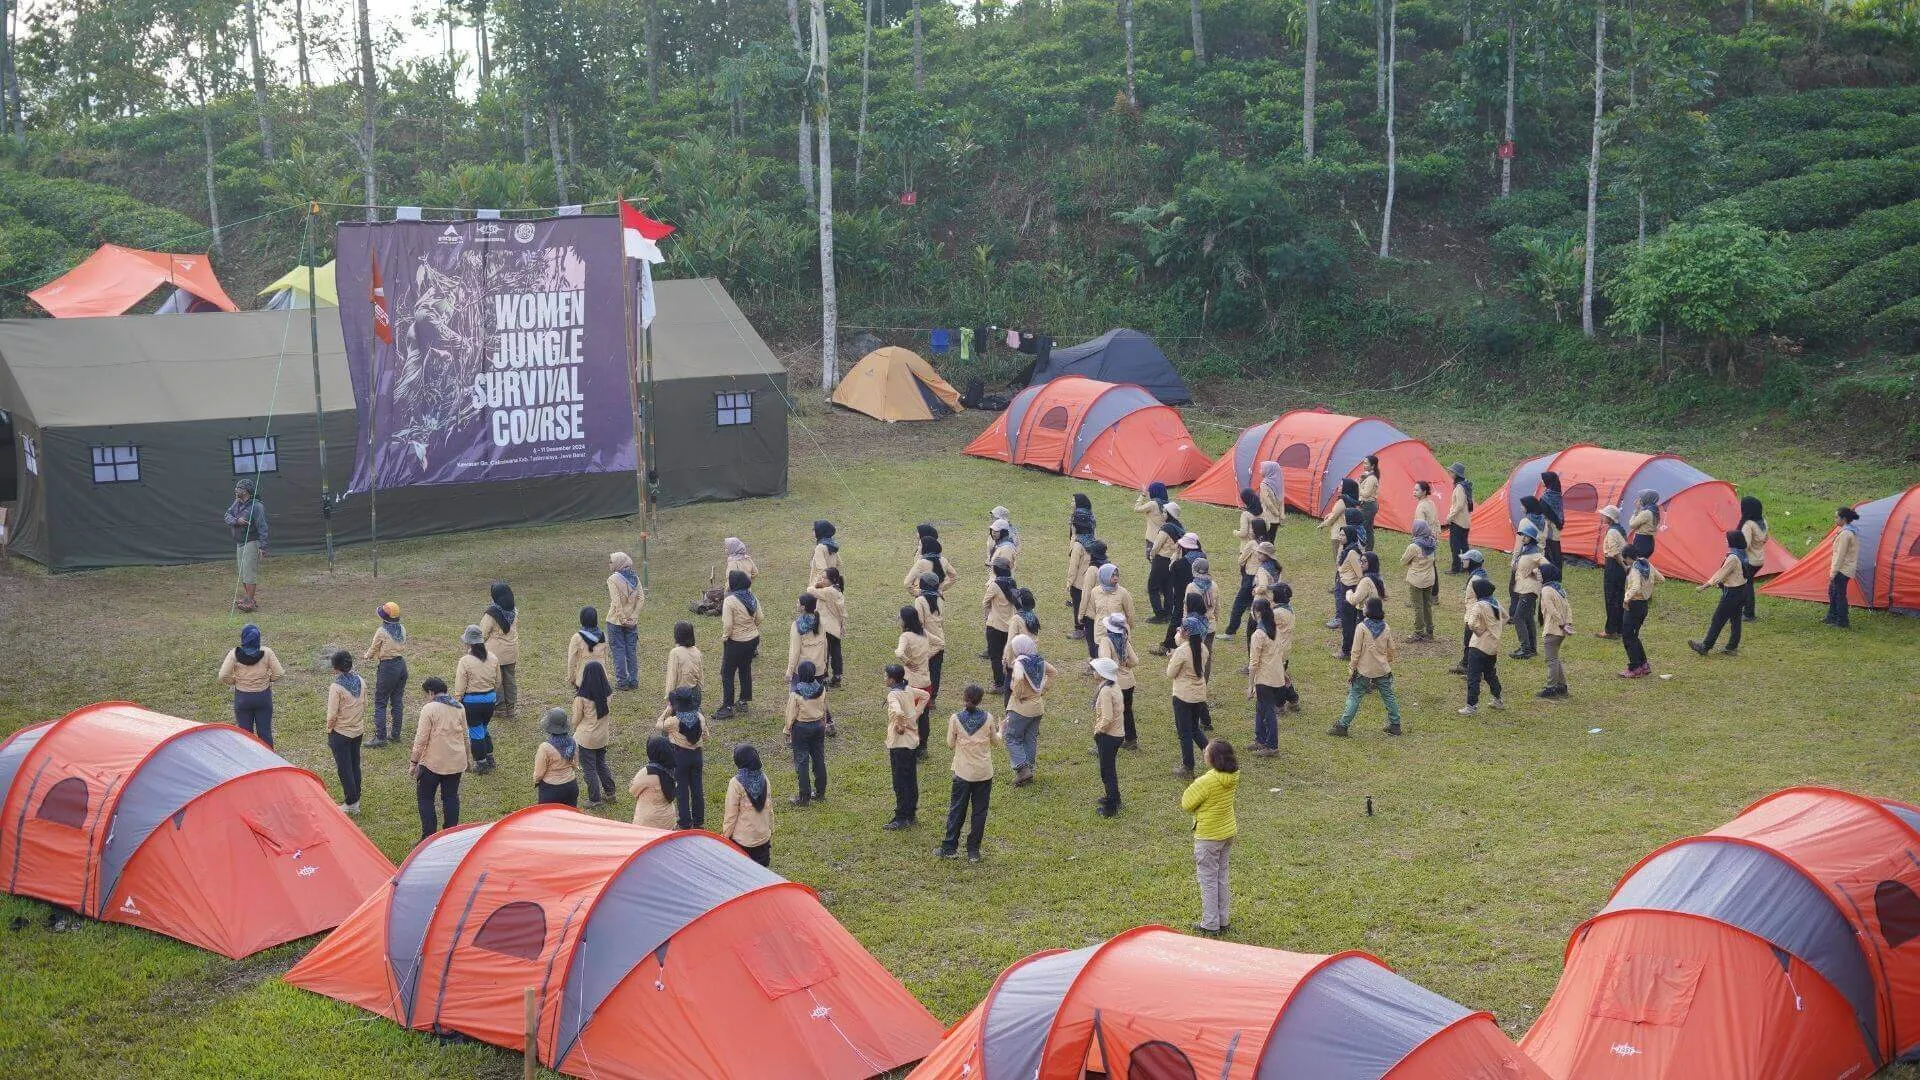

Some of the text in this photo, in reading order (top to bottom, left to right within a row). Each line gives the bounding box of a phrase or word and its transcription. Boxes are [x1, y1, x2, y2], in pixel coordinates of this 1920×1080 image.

[495, 290, 585, 330] WOMEN
[493, 328, 584, 369] JUNGLE
[472, 366, 584, 409] SURVIVAL
[492, 404, 585, 447] COURSE
